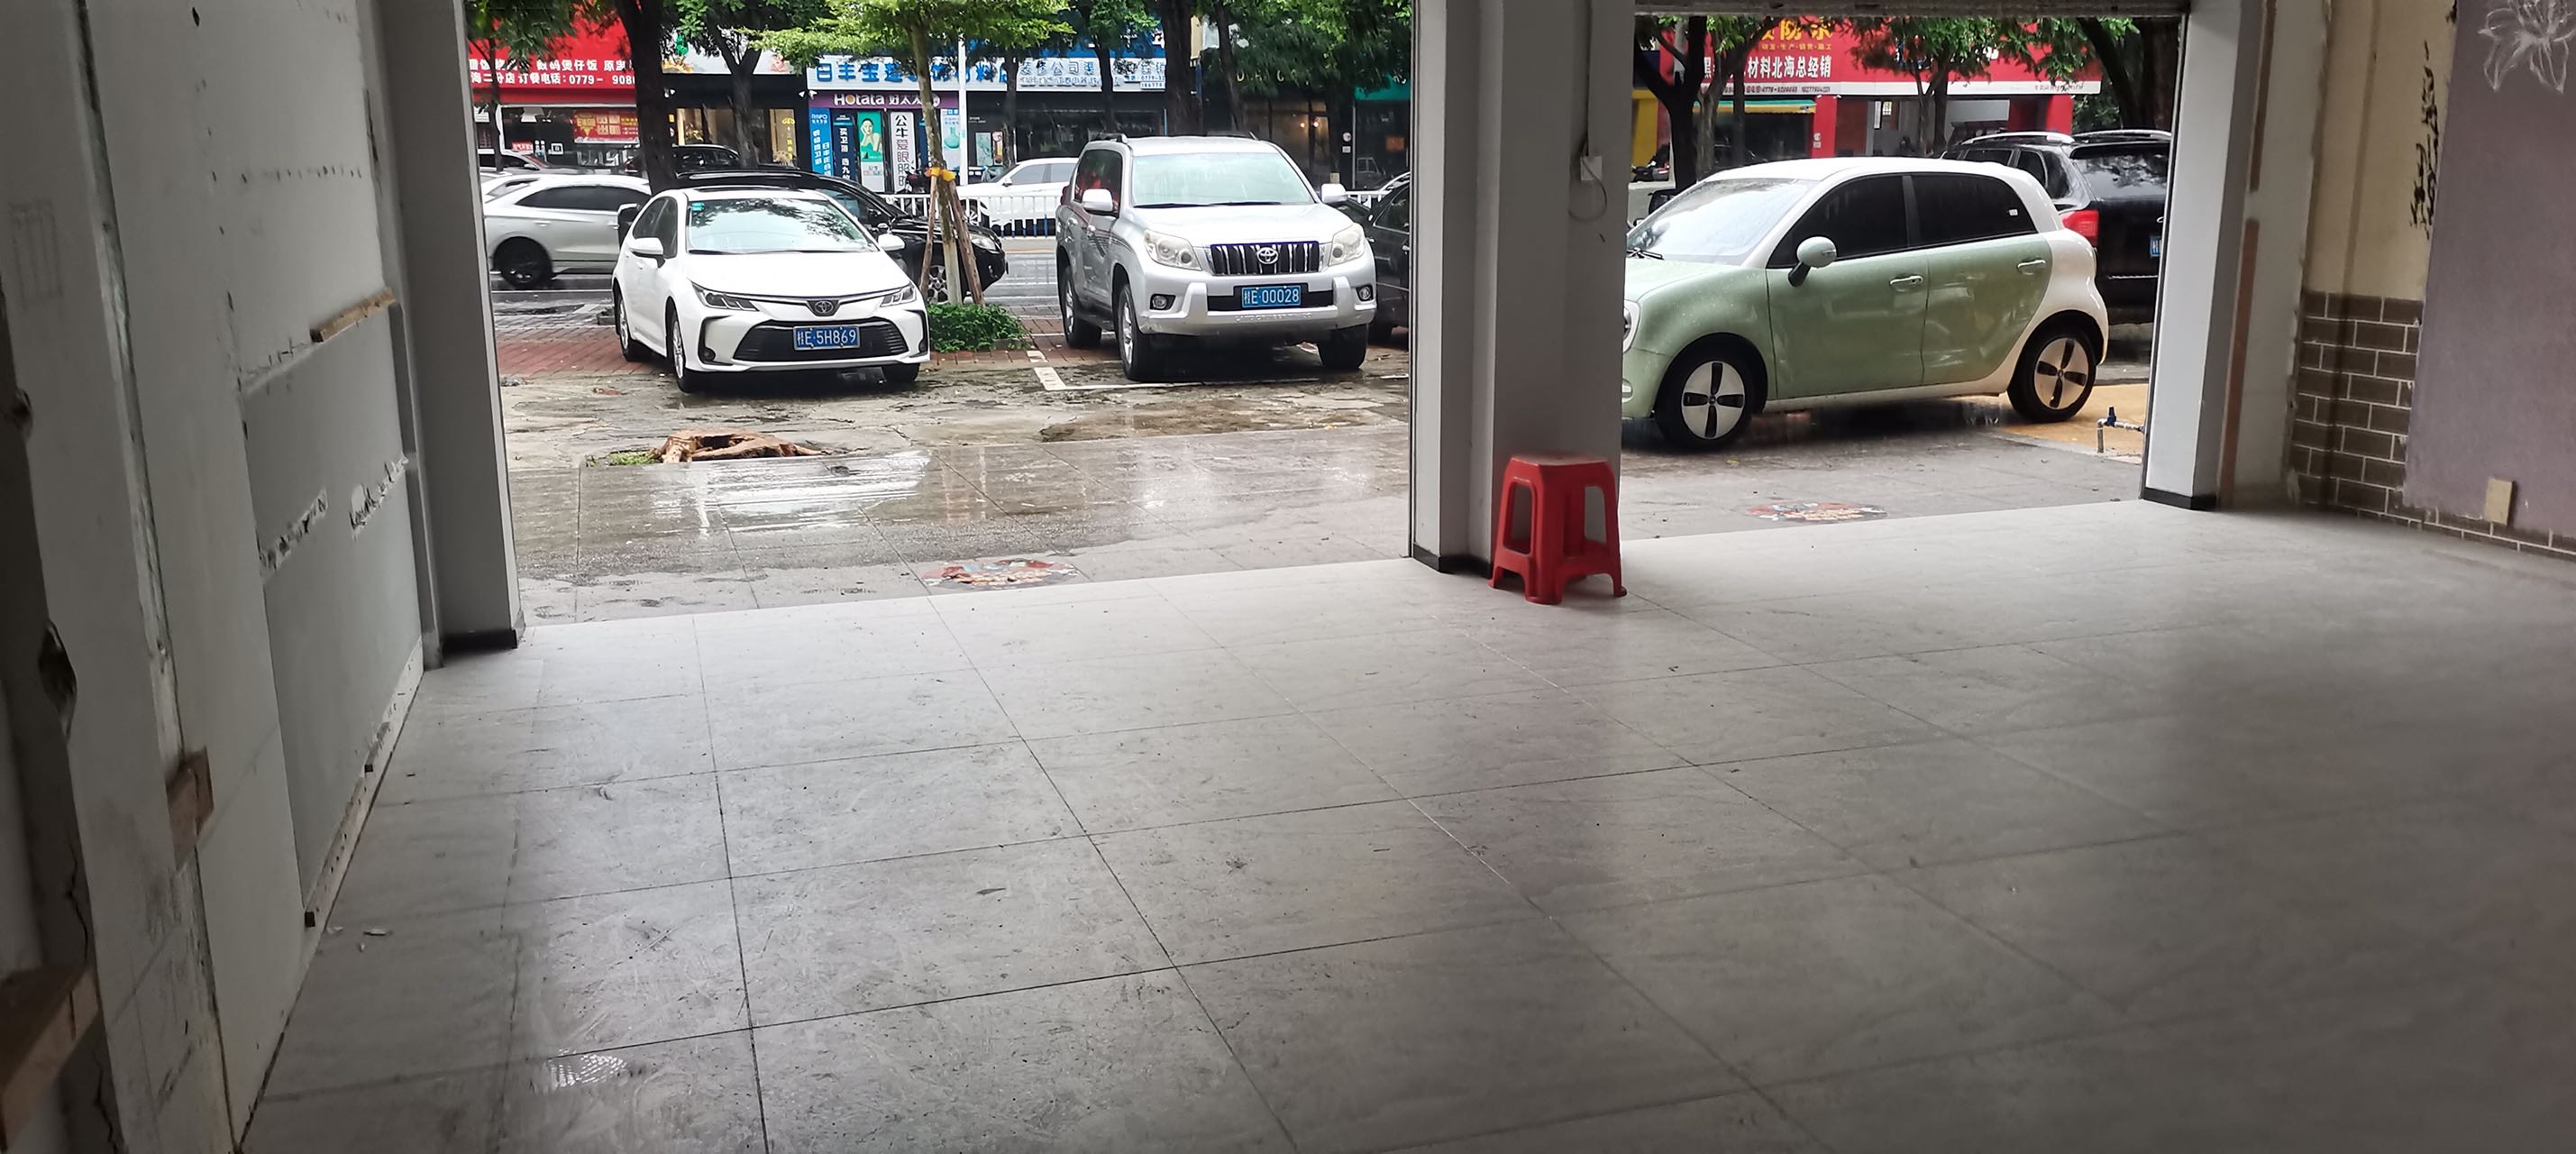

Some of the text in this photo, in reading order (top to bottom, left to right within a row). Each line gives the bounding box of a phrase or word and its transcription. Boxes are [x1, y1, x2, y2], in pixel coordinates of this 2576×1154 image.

[1748, 55, 1832, 78] 材料北海总经销
